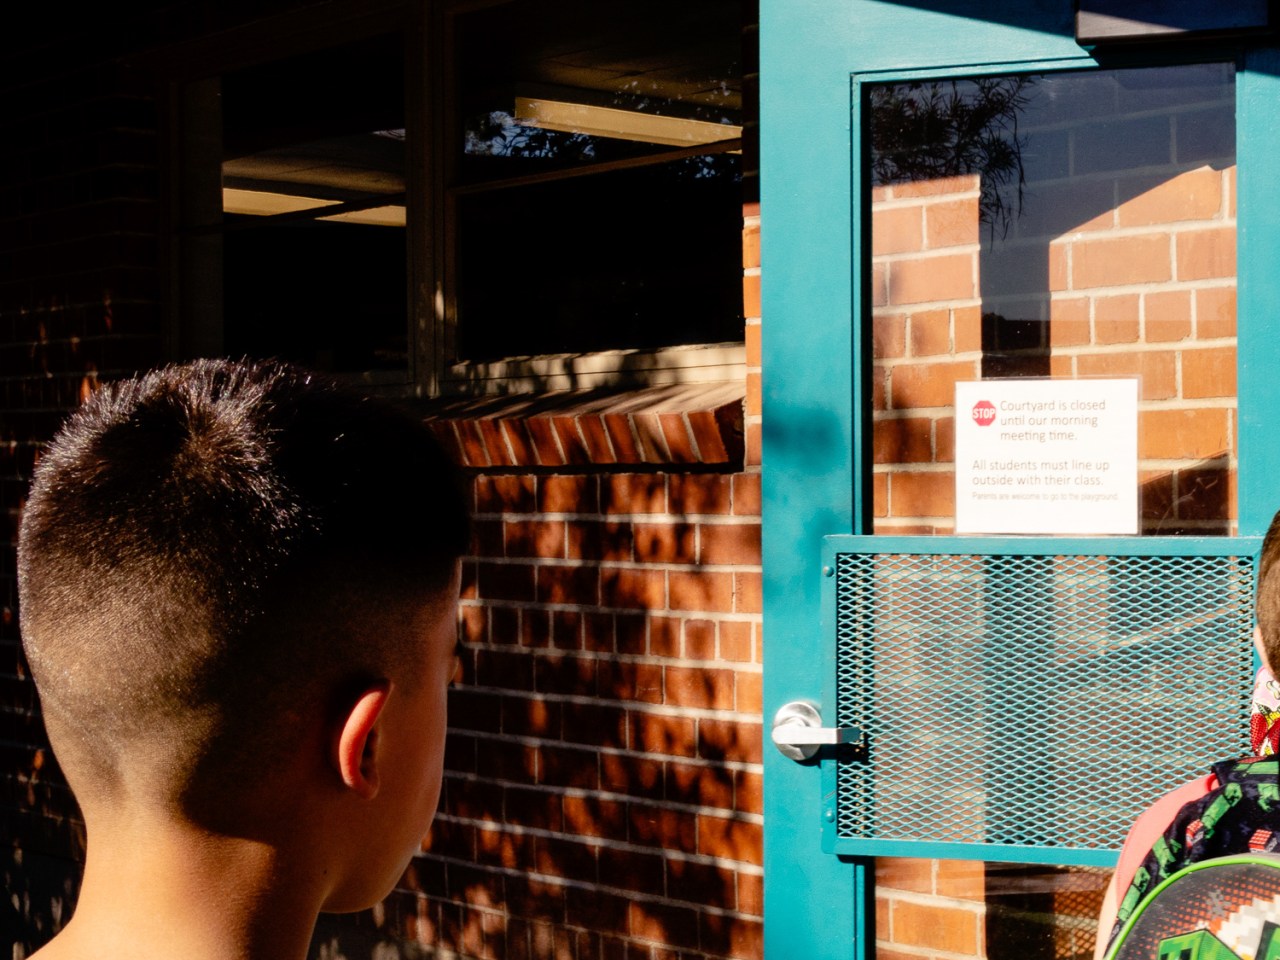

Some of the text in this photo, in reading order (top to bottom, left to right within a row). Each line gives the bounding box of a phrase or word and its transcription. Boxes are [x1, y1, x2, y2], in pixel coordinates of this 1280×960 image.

[1000, 399, 1106, 413] Courtyard is closed
[972, 408, 996, 419] STOP
[1000, 415, 1098, 428] until our morning
[1000, 430, 1078, 443] meeting time.
[972, 459, 1110, 473] All students must line up
[972, 475, 1104, 486] outside with their class.
[972, 492, 997, 500] Parents
[1011, 492, 1040, 500] welcome
[1069, 492, 1079, 500] the
